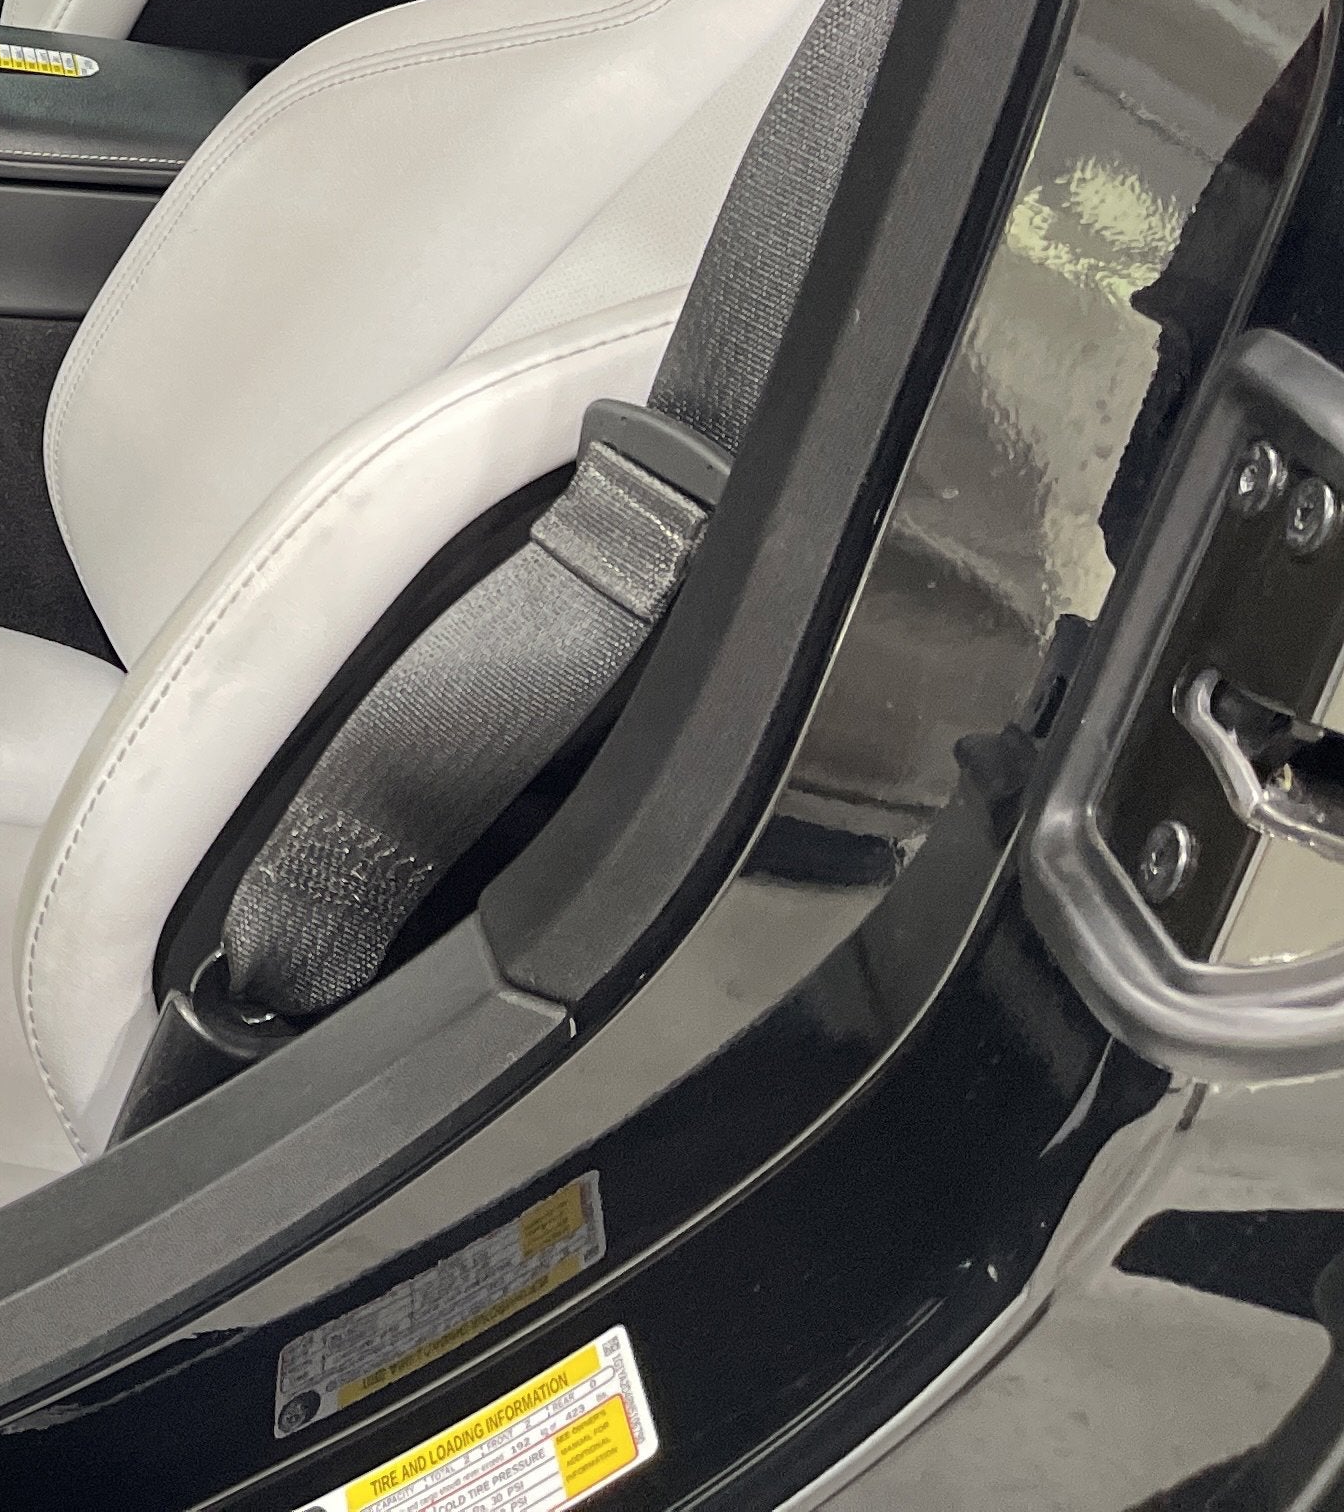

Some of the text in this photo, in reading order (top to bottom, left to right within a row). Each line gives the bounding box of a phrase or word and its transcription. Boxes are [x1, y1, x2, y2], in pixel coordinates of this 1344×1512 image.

[370, 1372, 569, 1496] TIRE AND LOADING INFORMATION
[565, 1404, 585, 1420] 423
[375, 1485, 415, 1512] CAPACITY
[431, 1465, 456, 1481] TOTAL
[486, 1429, 512, 1450] FRONT
[552, 1392, 574, 1411] REAR
[437, 1448, 545, 1512] COLD TIRE PRESSURE
[507, 1480, 524, 1497] PSI
